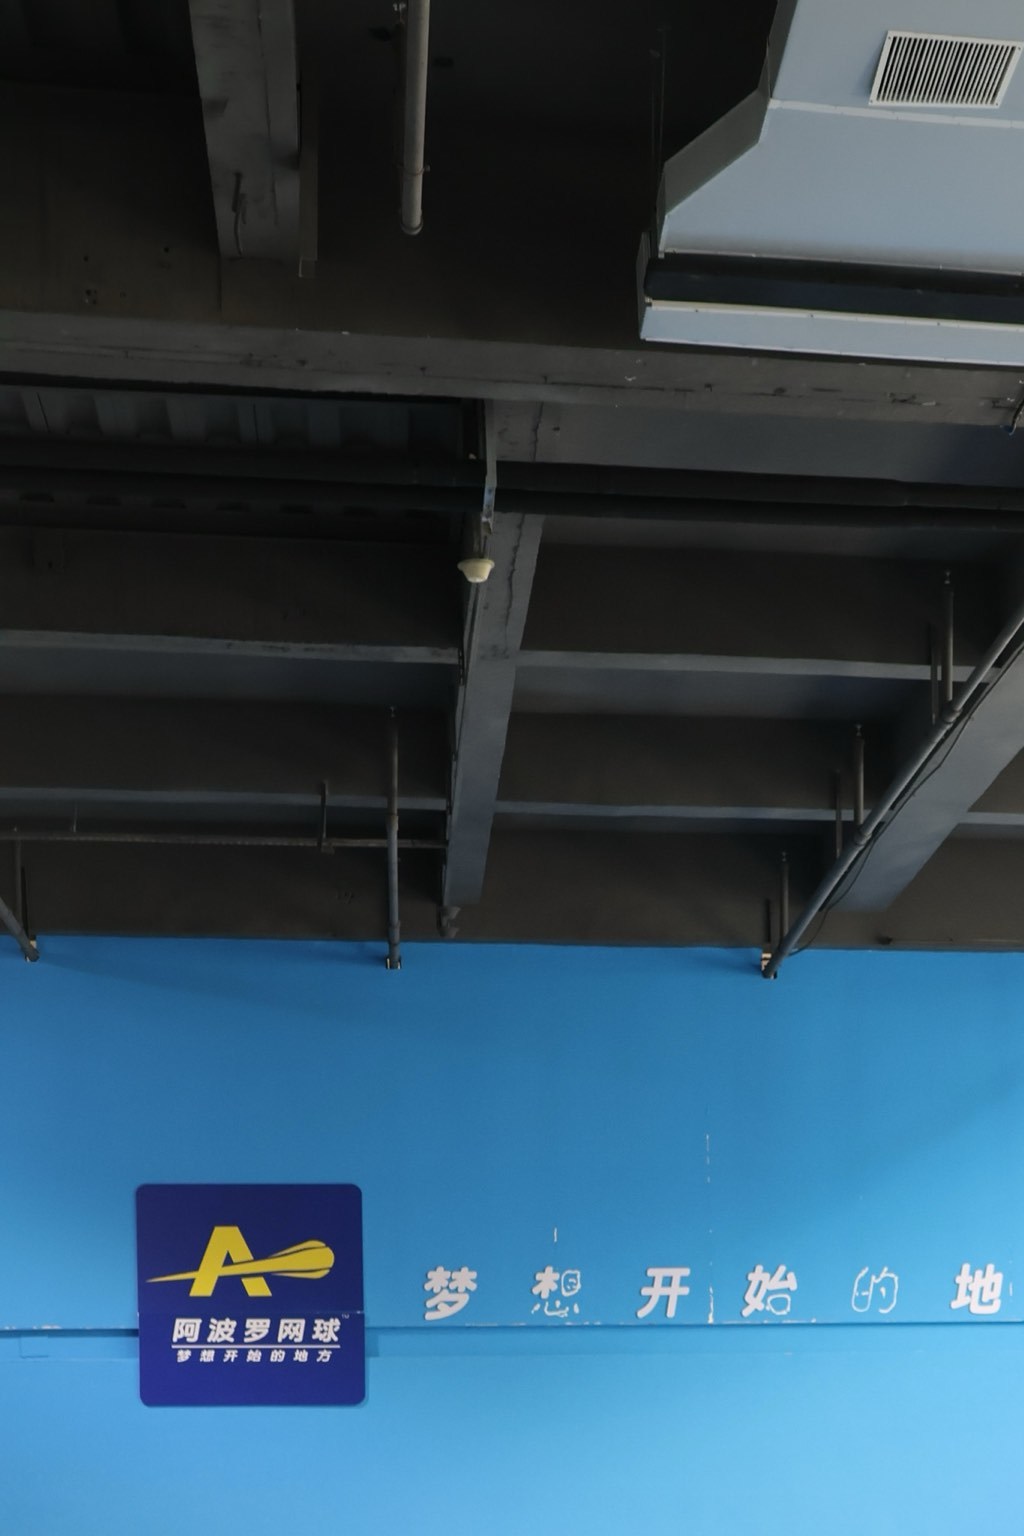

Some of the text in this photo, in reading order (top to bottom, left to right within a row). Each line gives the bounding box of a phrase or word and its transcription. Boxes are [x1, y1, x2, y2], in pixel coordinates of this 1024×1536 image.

[172, 1317, 341, 1343] 阿波罗网球
[177, 1349, 332, 1363] 梦想开始的地方
